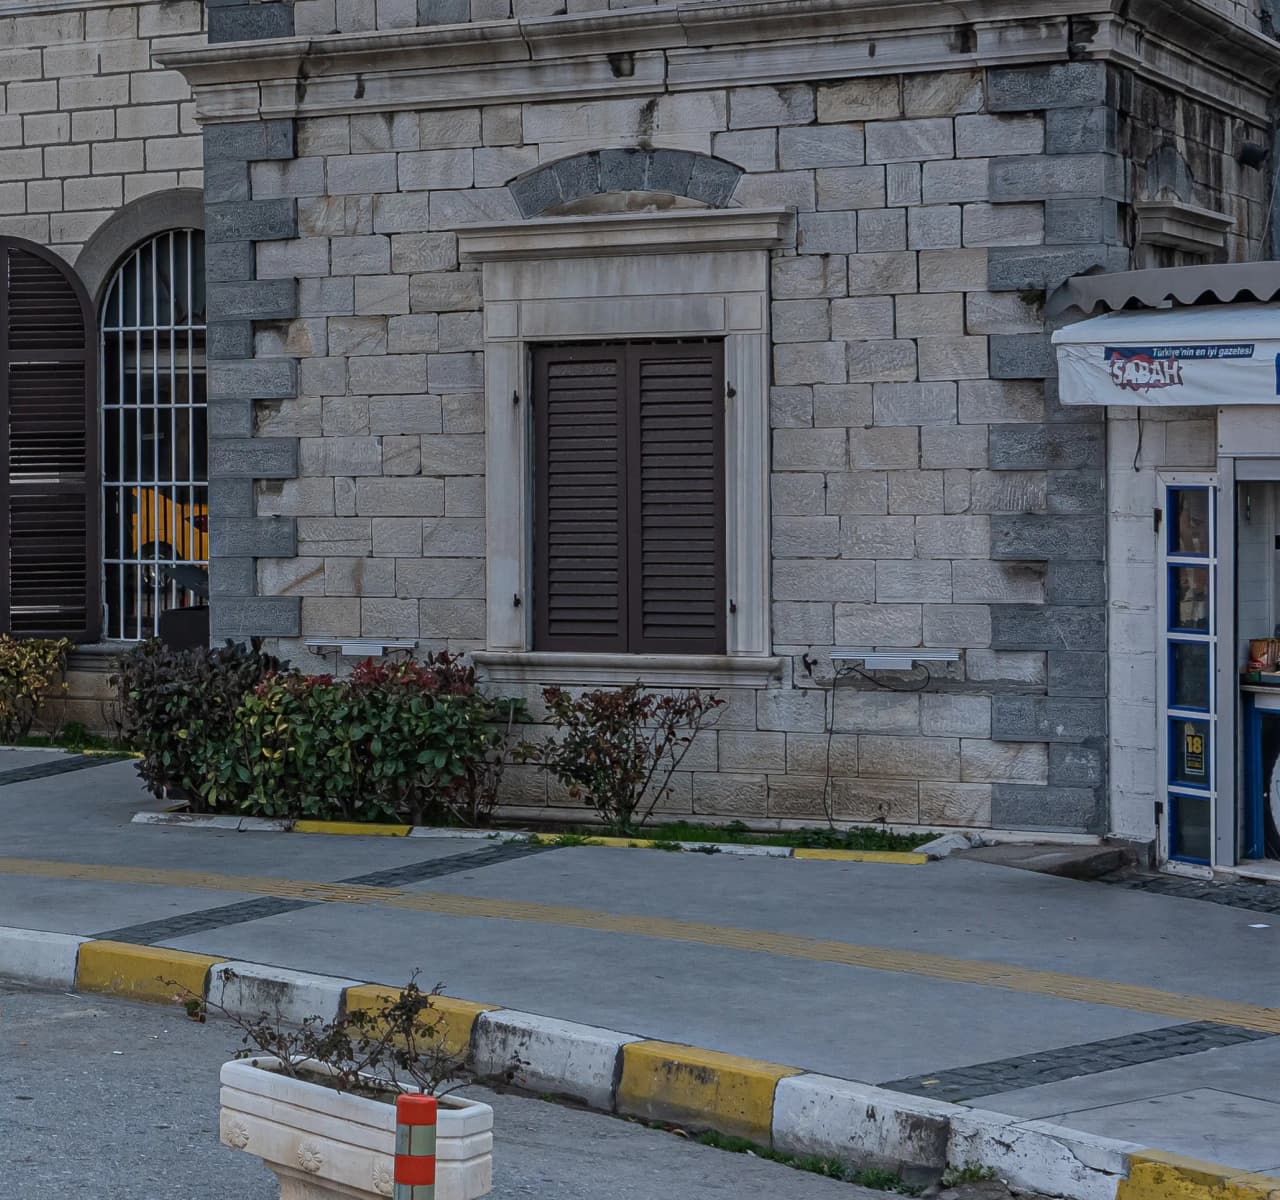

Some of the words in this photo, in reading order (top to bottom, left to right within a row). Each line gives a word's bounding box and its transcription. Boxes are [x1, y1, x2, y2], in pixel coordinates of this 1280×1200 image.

[1152, 347, 1194, 358] Türkiye'nin
[1195, 348, 1206, 356] en
[1207, 345, 1218, 358] iyi
[1218, 345, 1252, 357] gazetesi
[1112, 359, 1181, 385] SABAH
[1187, 735, 1202, 754] 18
